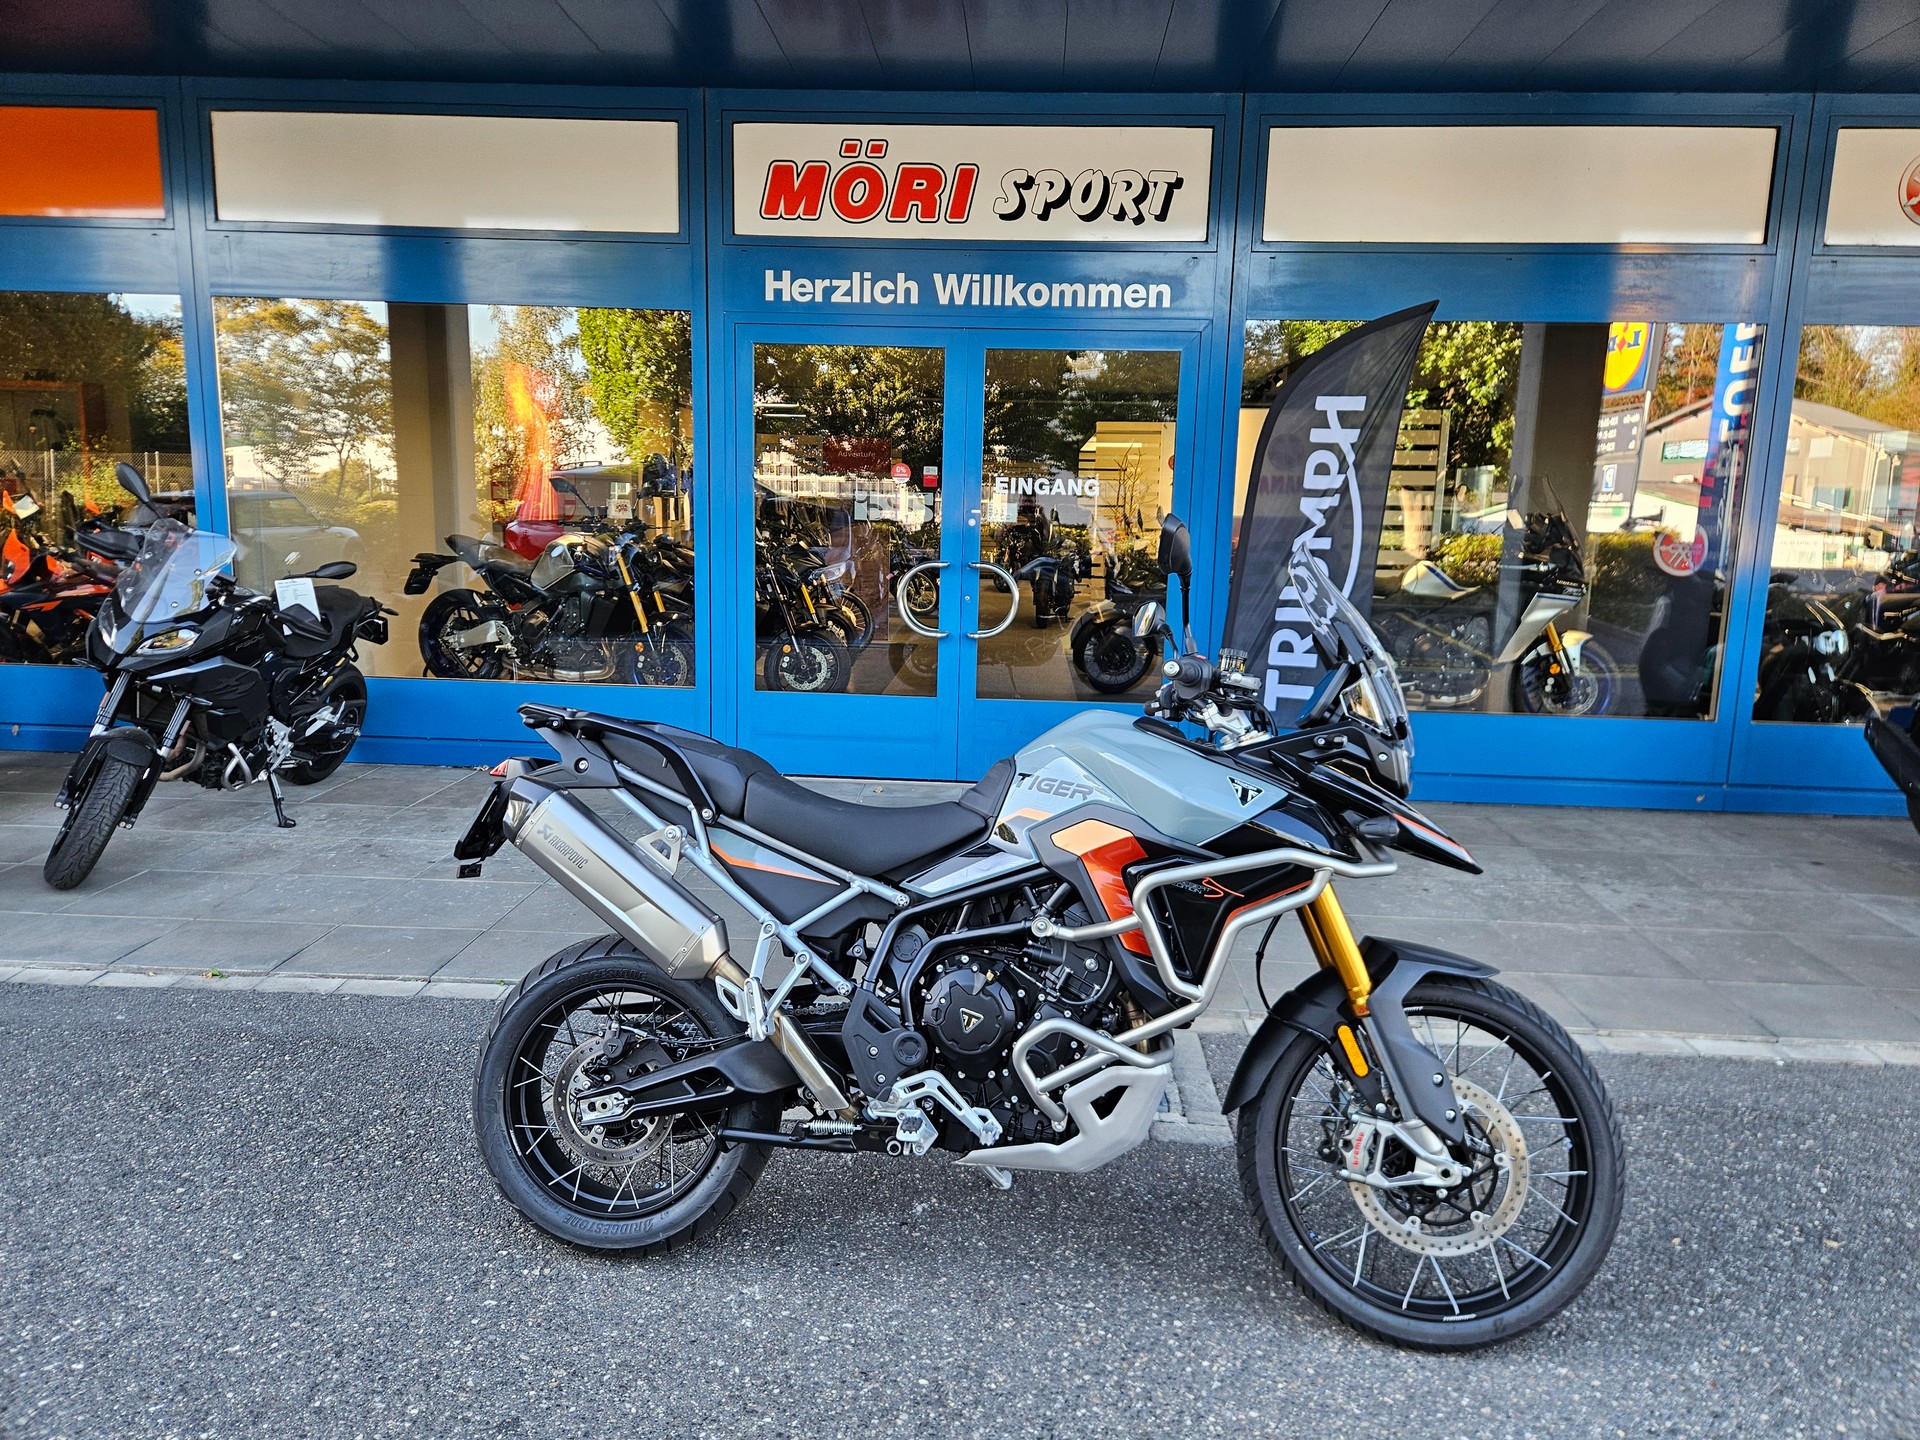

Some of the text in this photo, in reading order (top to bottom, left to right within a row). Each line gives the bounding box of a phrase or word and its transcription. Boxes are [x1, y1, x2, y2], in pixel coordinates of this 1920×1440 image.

[759, 138, 1184, 226] MÖRI SPORT
[764, 269, 1171, 308] Herzlich Willkommen
[837, 450, 876, 458] Adventure
[895, 466, 907, 474] 0%
[995, 476, 1100, 496] EINGANG
[1263, 395, 1367, 712] TRIUMPH
[1015, 772, 1094, 801] TIGER
[562, 1214, 655, 1236] BRIDGESTONE
